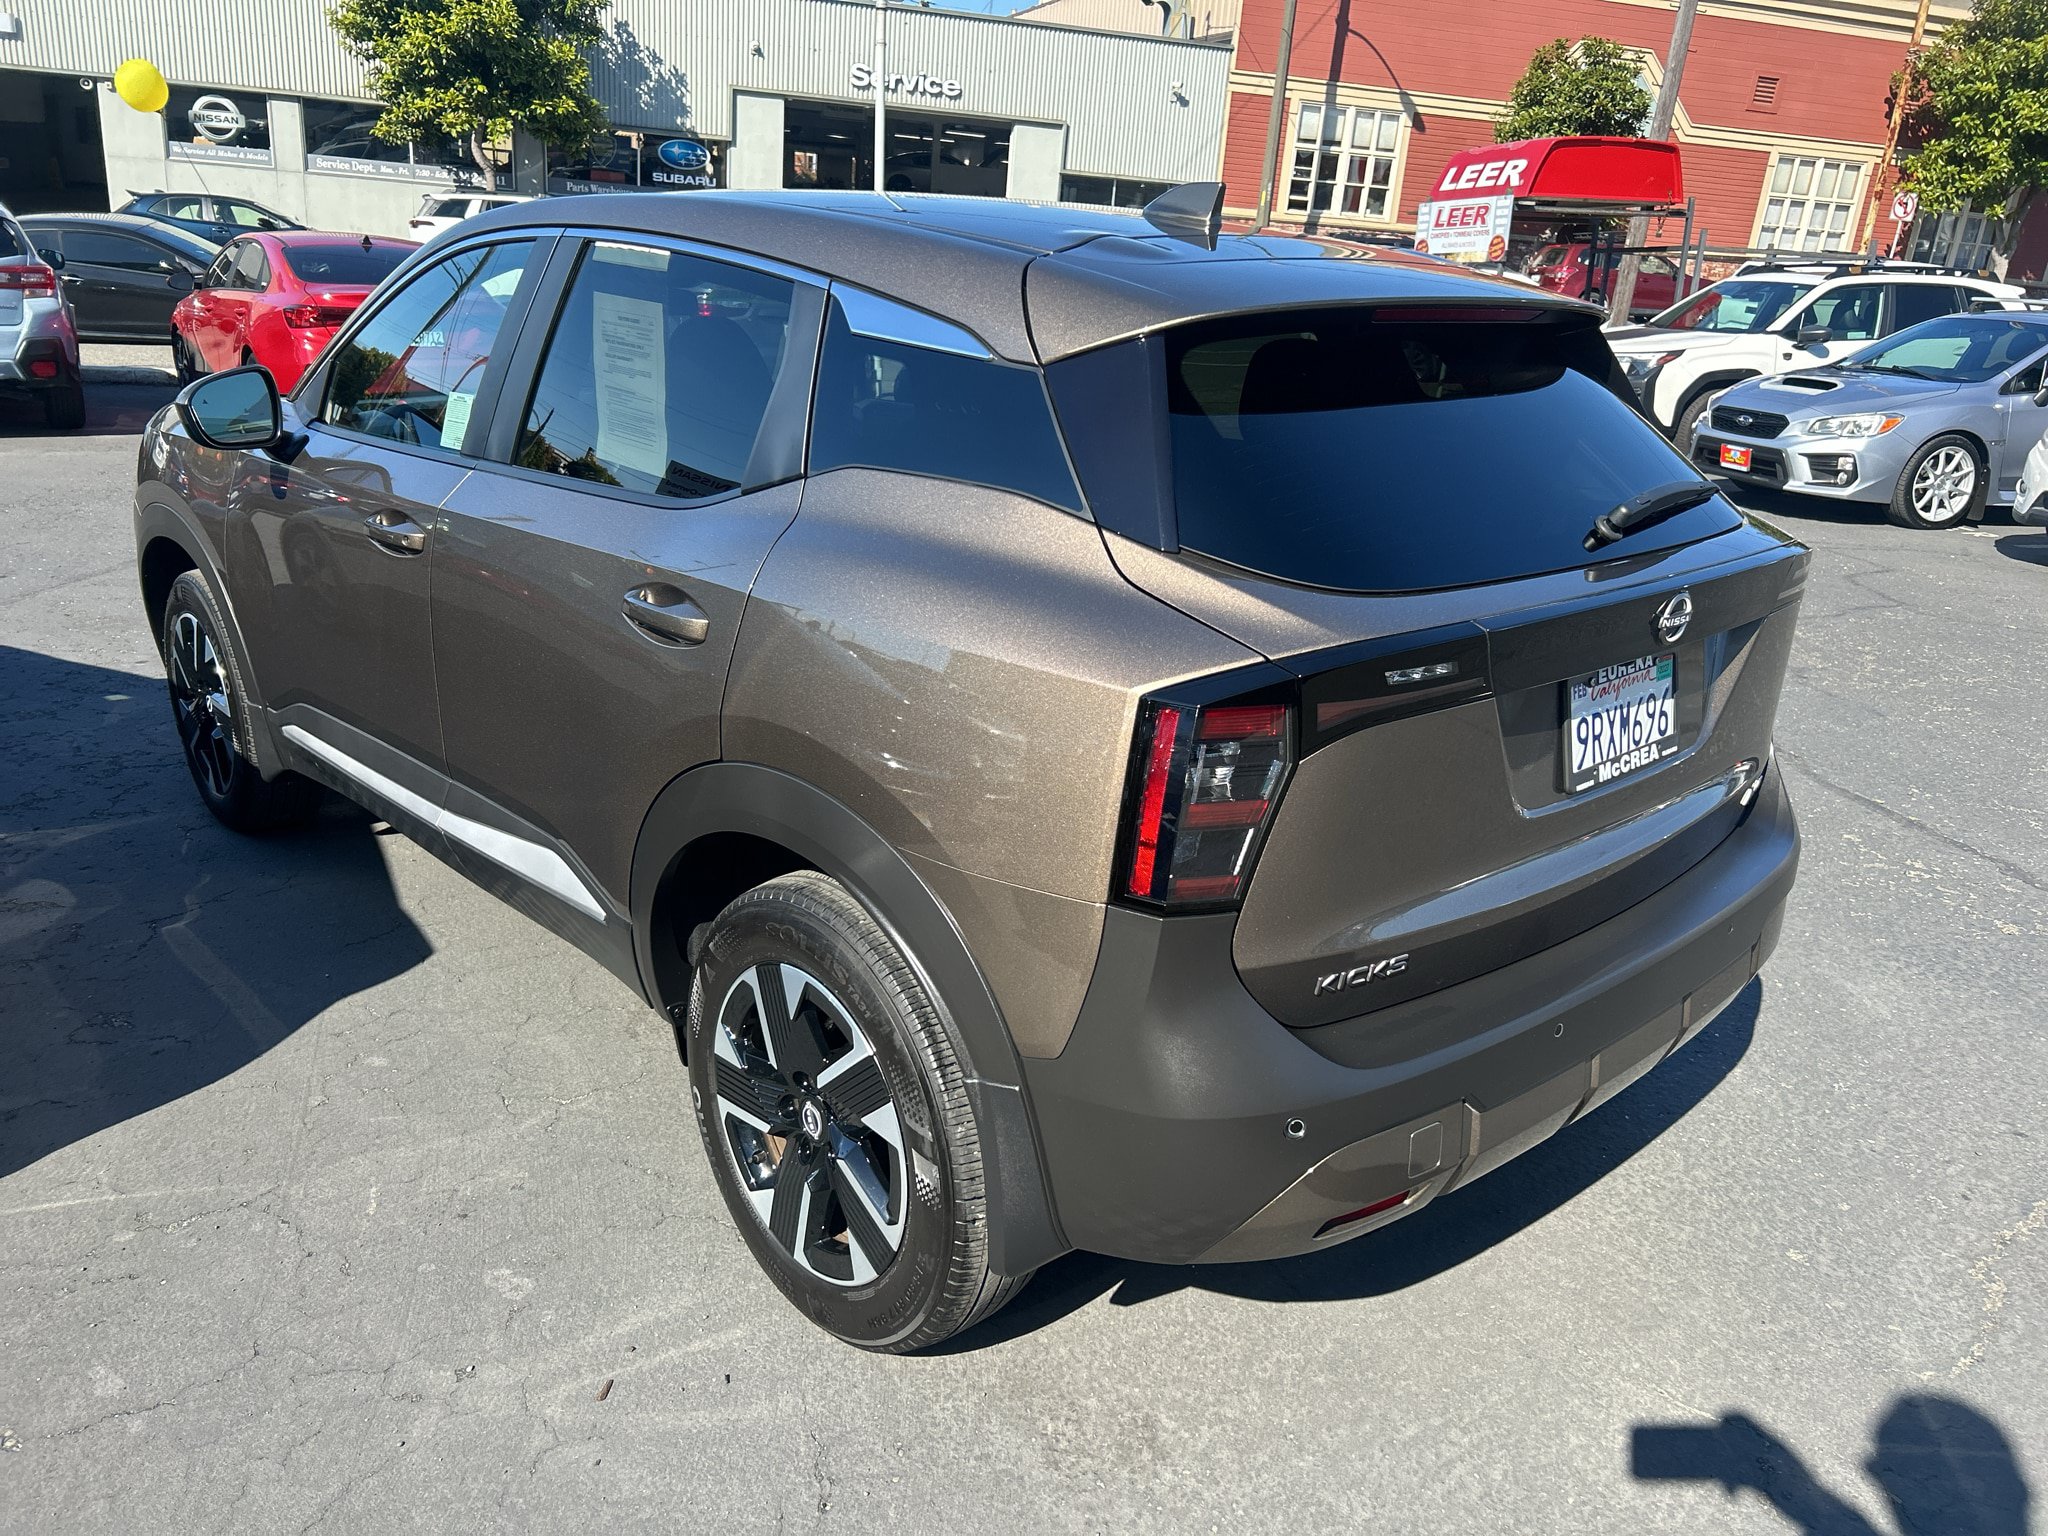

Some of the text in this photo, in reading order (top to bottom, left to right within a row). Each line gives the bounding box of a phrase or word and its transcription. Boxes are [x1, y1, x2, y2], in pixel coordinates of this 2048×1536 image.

[193, 113, 239, 125] NISSAN
[316, 158, 350, 170] Service
[351, 160, 376, 173] Dept.
[1438, 159, 1528, 191] LEER
[566, 181, 589, 193] Parts
[652, 172, 717, 187] SUBARU
[1433, 205, 1490, 228] LEER
[1573, 683, 1587, 701] FEB
[1590, 669, 1656, 702] California
[1576, 685, 1671, 771] 9RXM696
[1598, 743, 1660, 783] McCREA
[1313, 953, 1409, 996] KICKS
